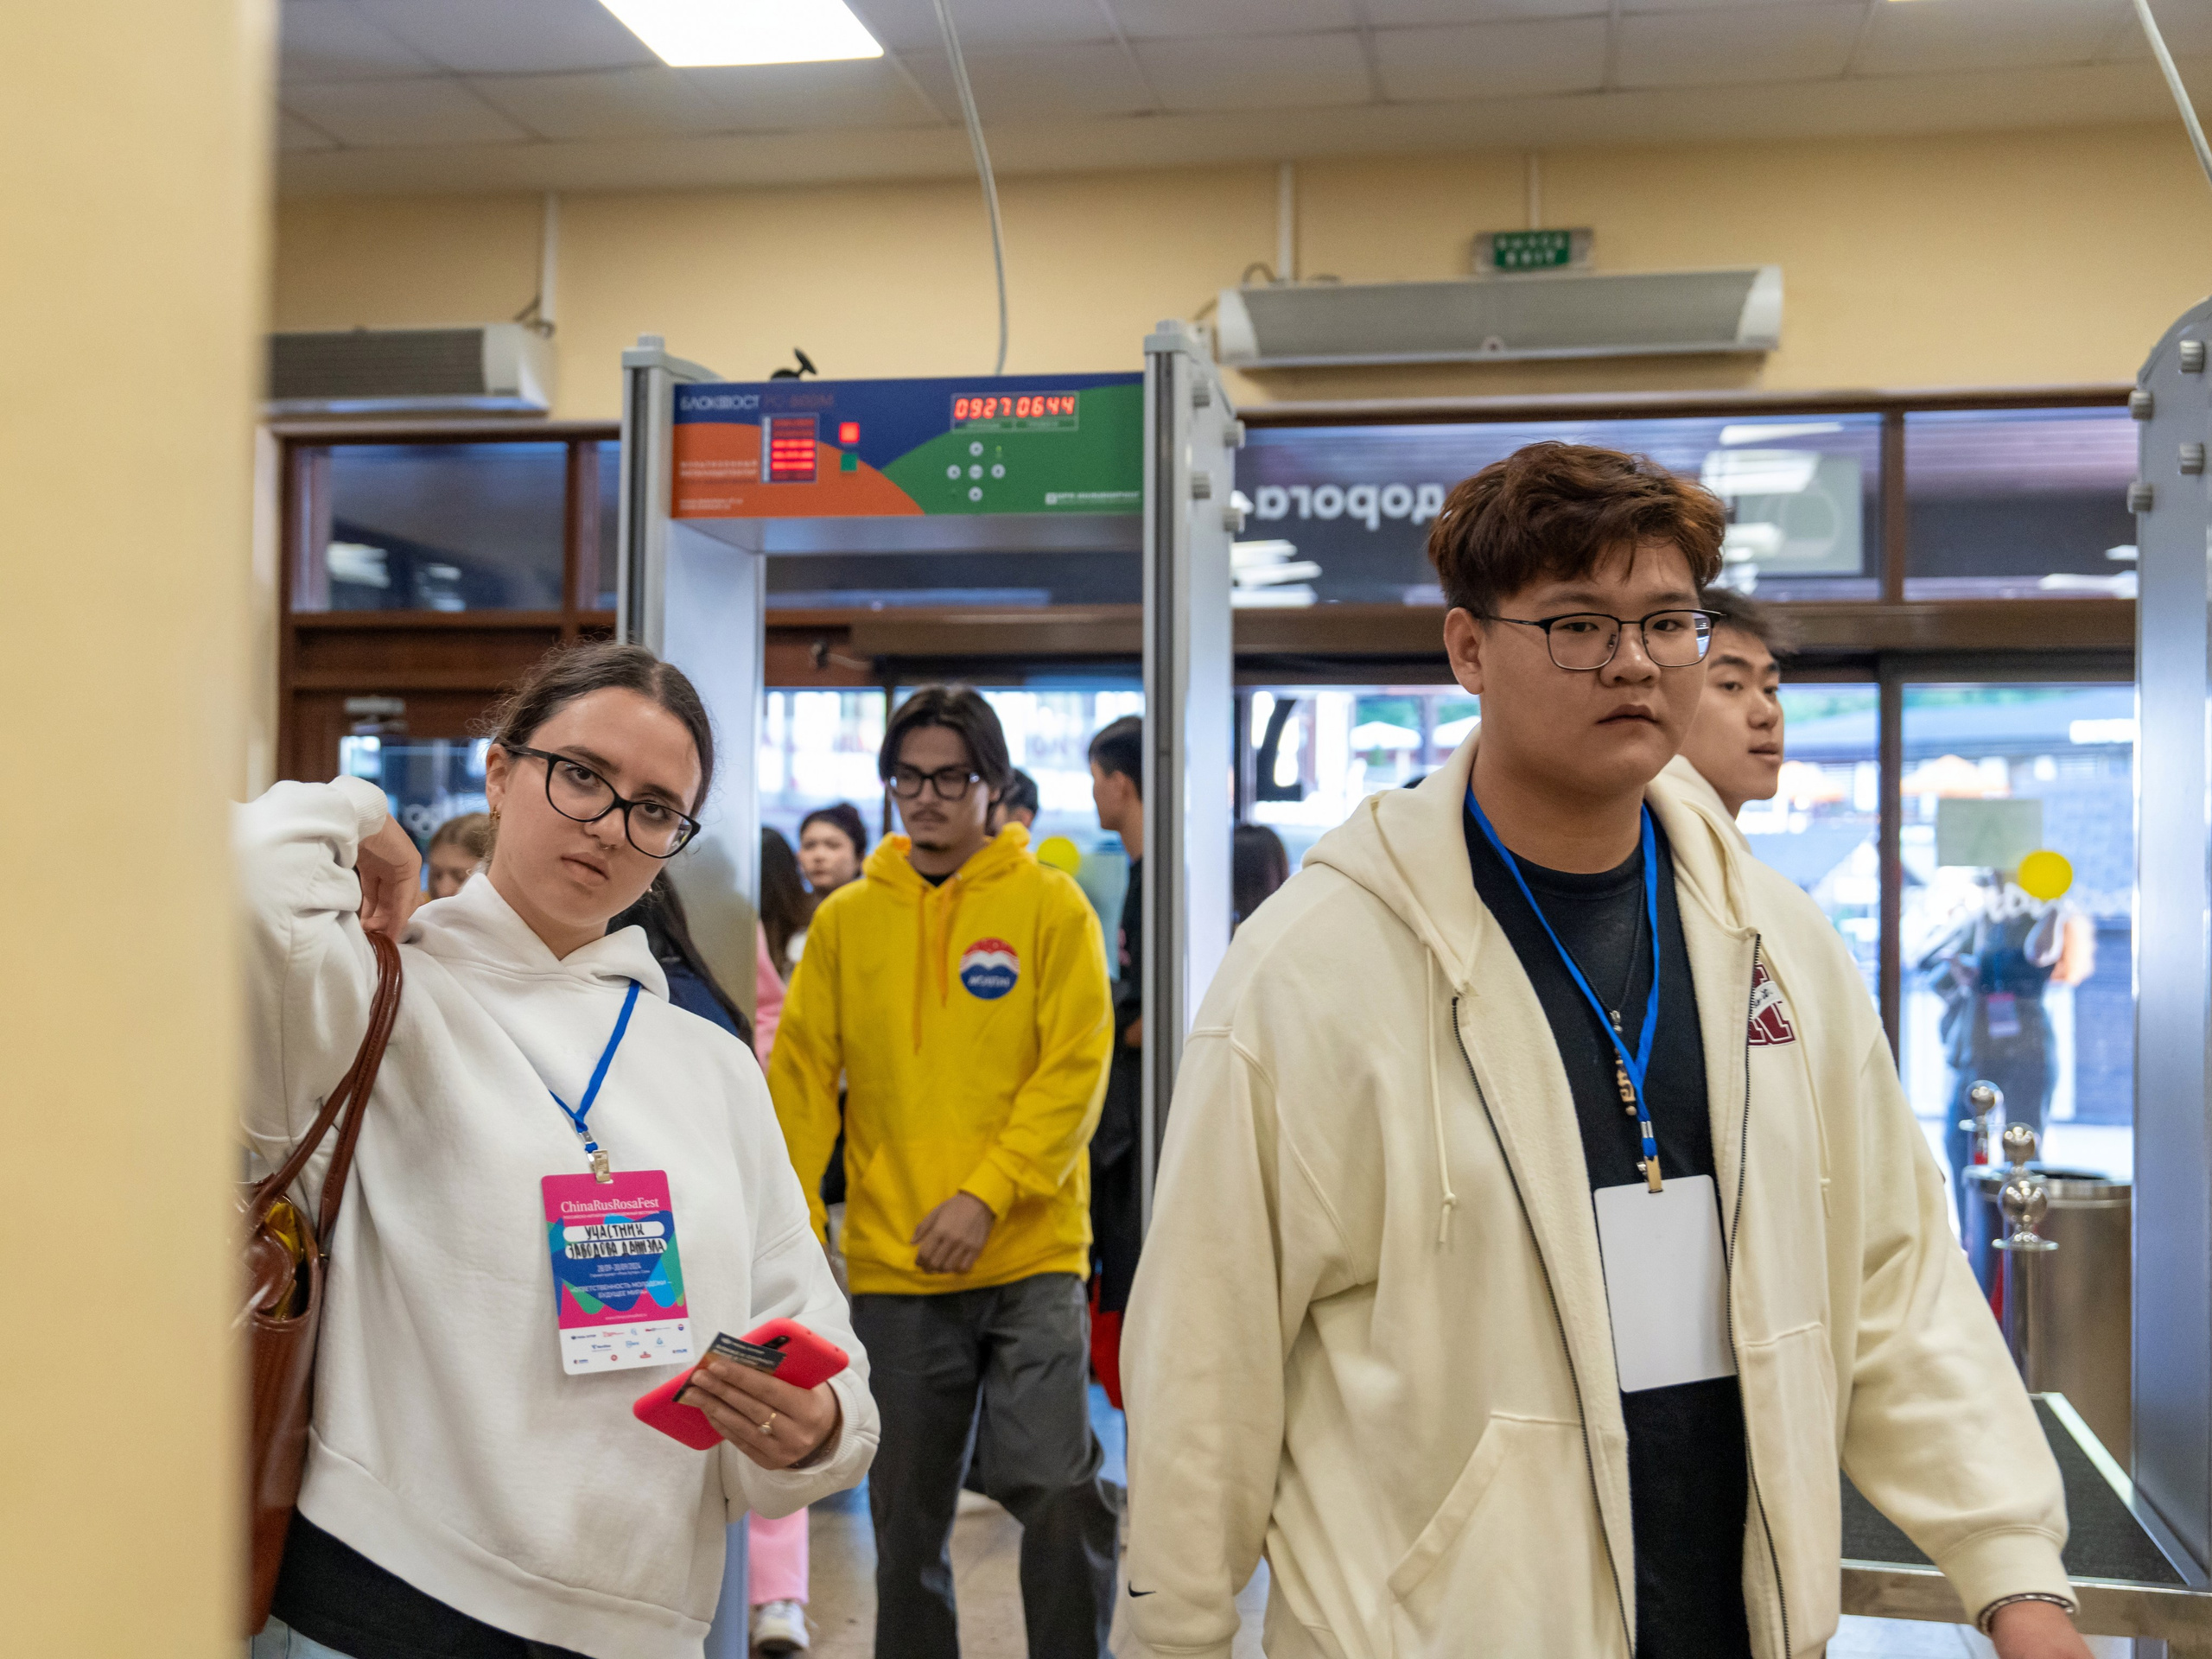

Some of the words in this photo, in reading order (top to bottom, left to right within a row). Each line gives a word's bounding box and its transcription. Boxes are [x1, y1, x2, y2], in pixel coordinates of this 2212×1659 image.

[954, 397, 1012, 420] 0927
[1015, 396, 1075, 417] 0644
[560, 1197, 659, 1213] ChinaRusRosaFest
[584, 1223, 645, 1240] УЧАСТНИК
